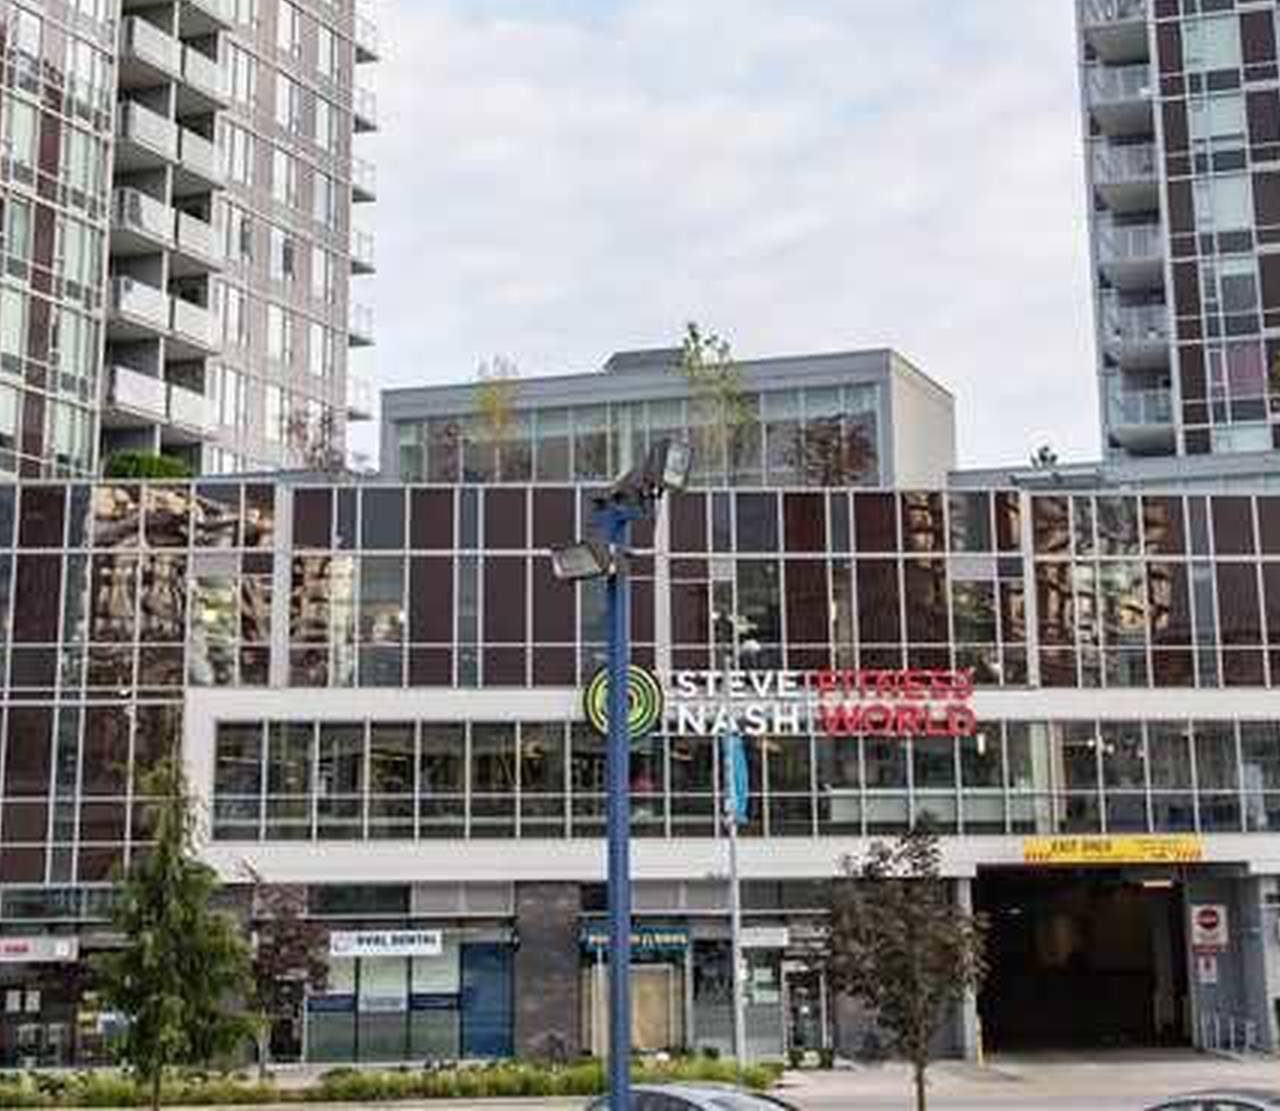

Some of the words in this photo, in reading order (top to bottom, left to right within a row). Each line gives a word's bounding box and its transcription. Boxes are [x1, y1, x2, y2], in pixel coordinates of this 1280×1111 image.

[676, 670, 799, 698] STEVE
[818, 668, 976, 701] FITNESS
[677, 705, 800, 735] NASH
[820, 705, 977, 736] WORLD
